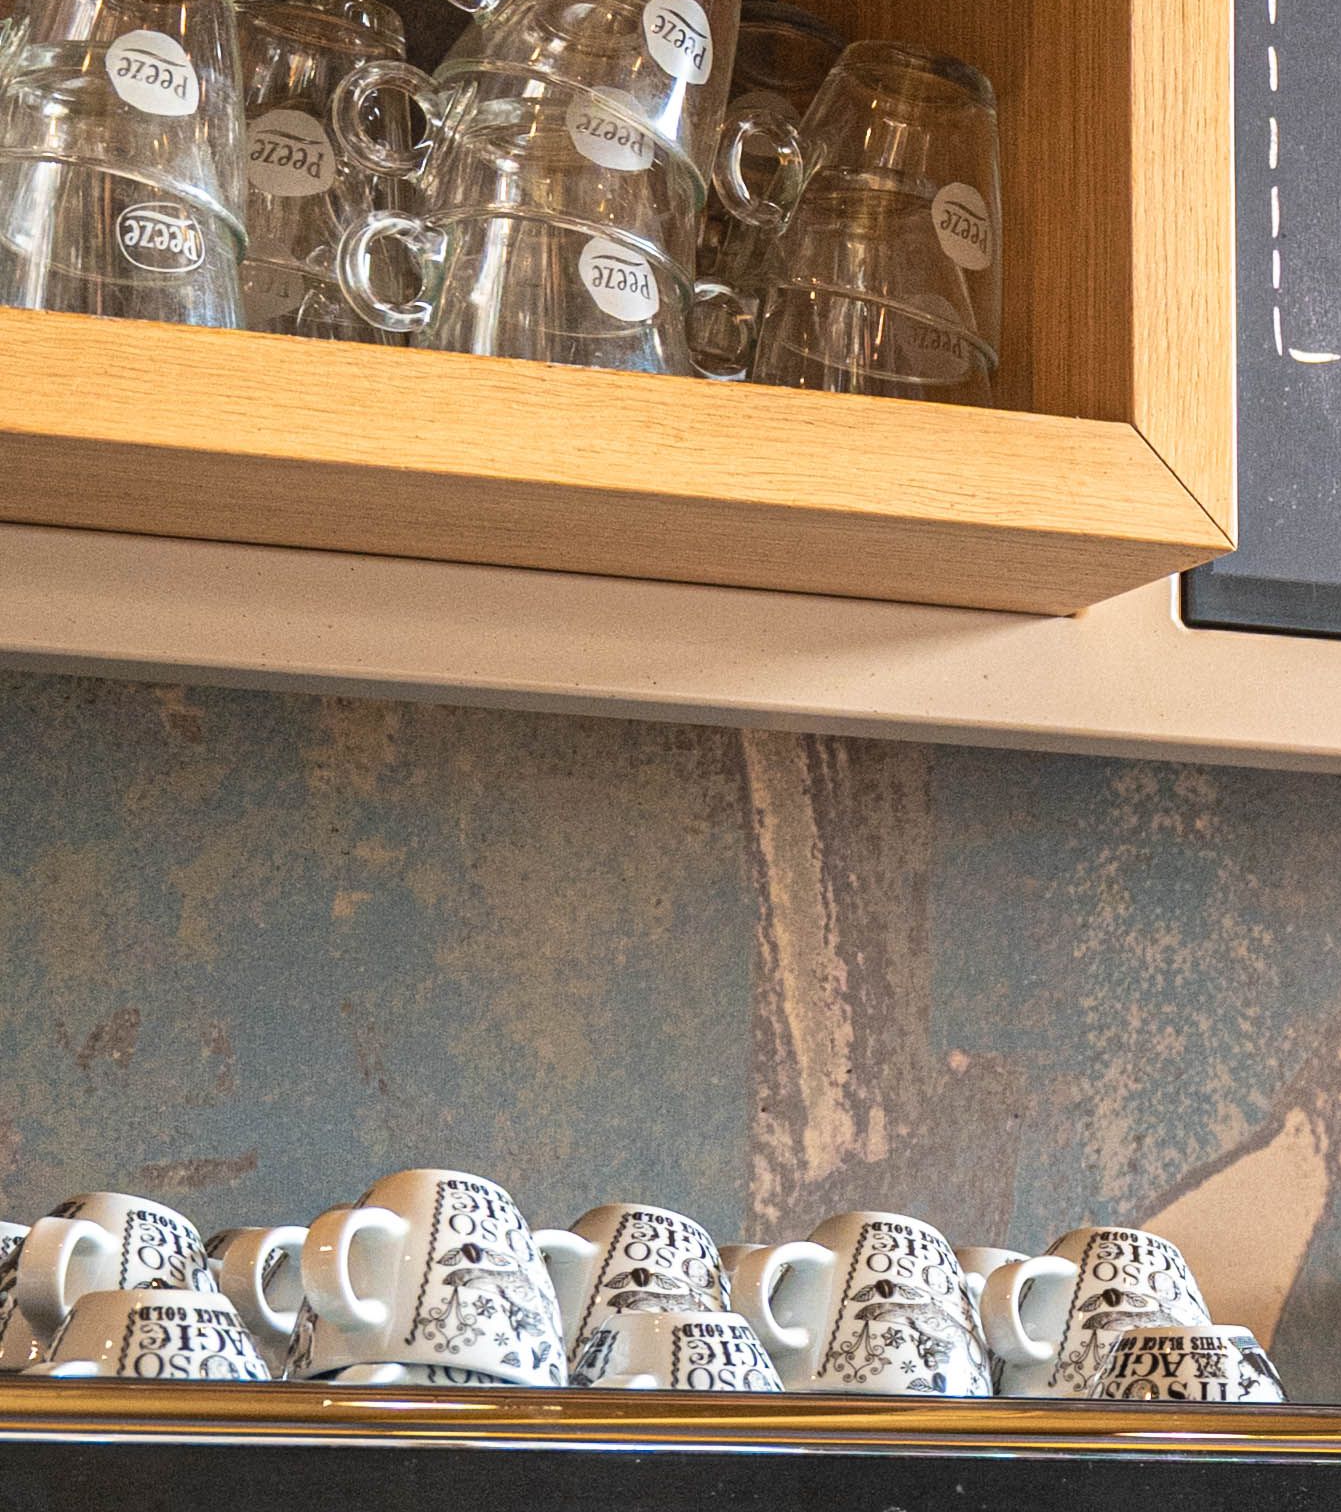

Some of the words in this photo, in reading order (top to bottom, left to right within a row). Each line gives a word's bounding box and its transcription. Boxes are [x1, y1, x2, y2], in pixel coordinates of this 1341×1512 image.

[114, 55, 190, 103] Peeze
[248, 137, 325, 180] Peeze
[123, 218, 199, 263] Peeze
[938, 209, 989, 255] Peeze
[590, 265, 652, 302] Peeze
